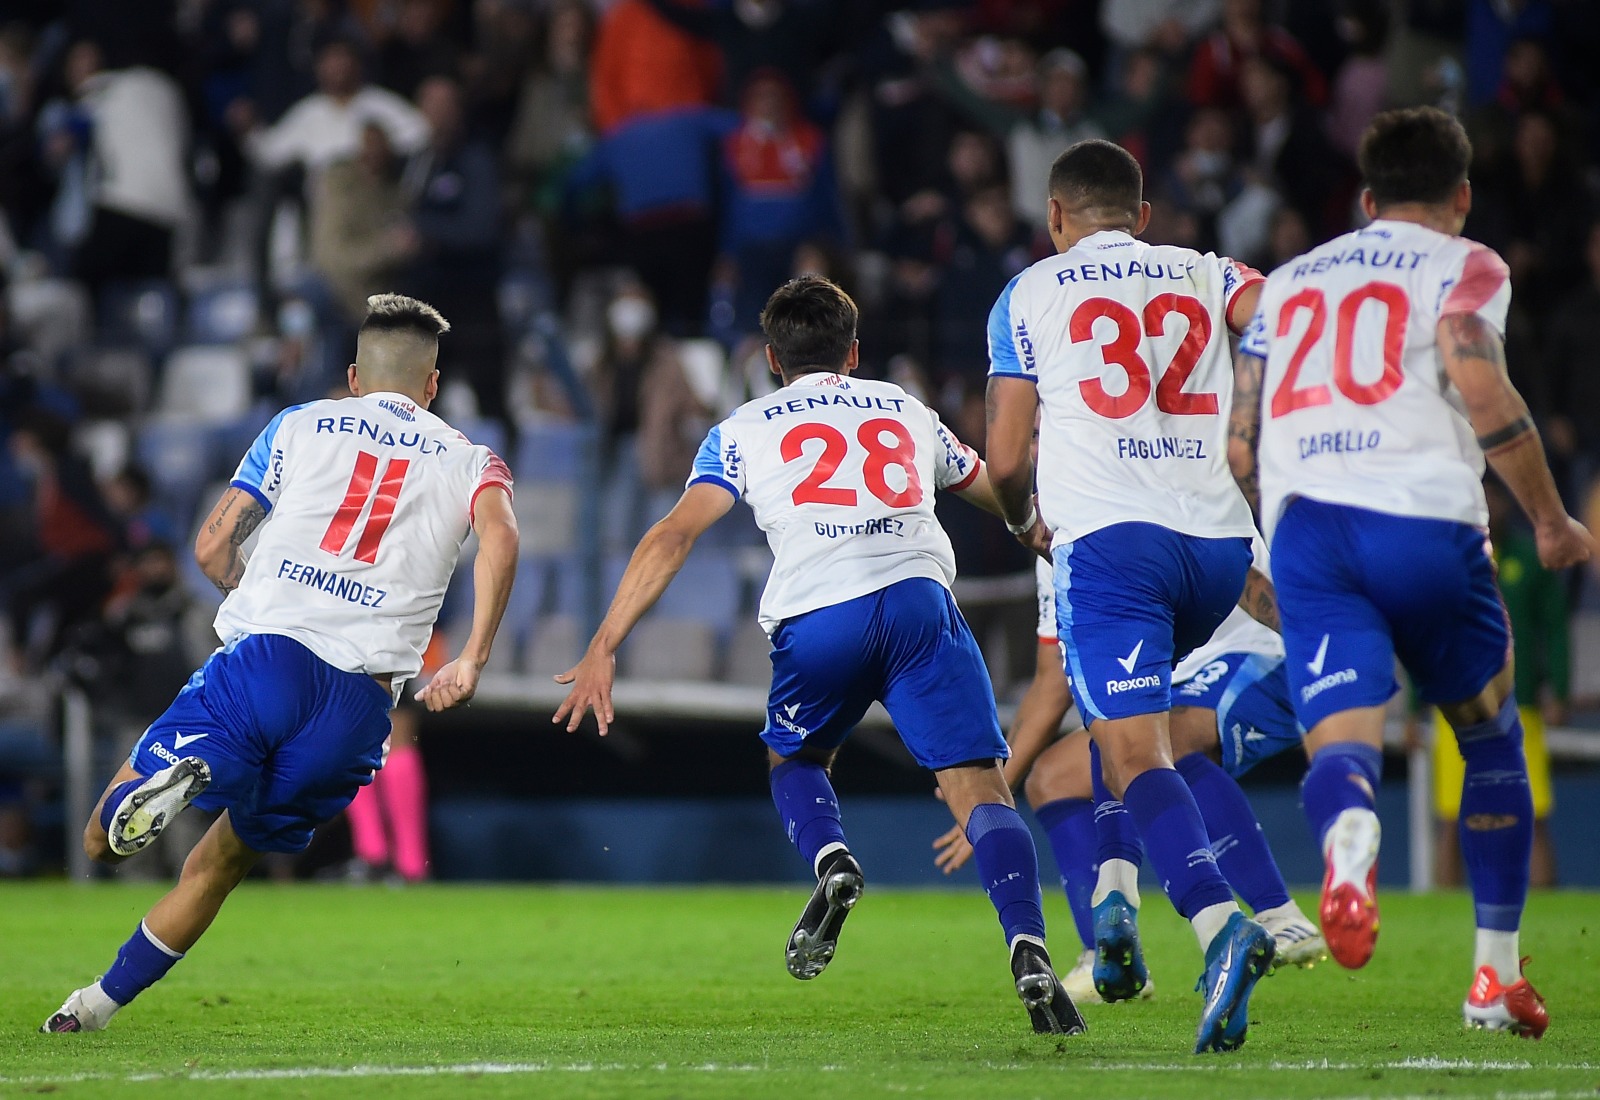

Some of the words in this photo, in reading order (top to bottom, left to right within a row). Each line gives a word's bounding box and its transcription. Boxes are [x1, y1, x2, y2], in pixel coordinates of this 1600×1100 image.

[1293, 248, 1429, 280] RENAULT
[1069, 292, 1220, 419] 32
[1271, 280, 1411, 419] 20
[378, 400, 416, 422] GANADORA
[763, 394, 905, 420] RENAULT
[316, 416, 448, 457] RENAULT
[780, 418, 924, 509] 28
[319, 450, 411, 565] 11
[277, 559, 387, 609] FERNANDEZ
[1106, 675, 1161, 695] Rexona
[1301, 668, 1358, 705] Rexona
[149, 741, 180, 766] Rexo
